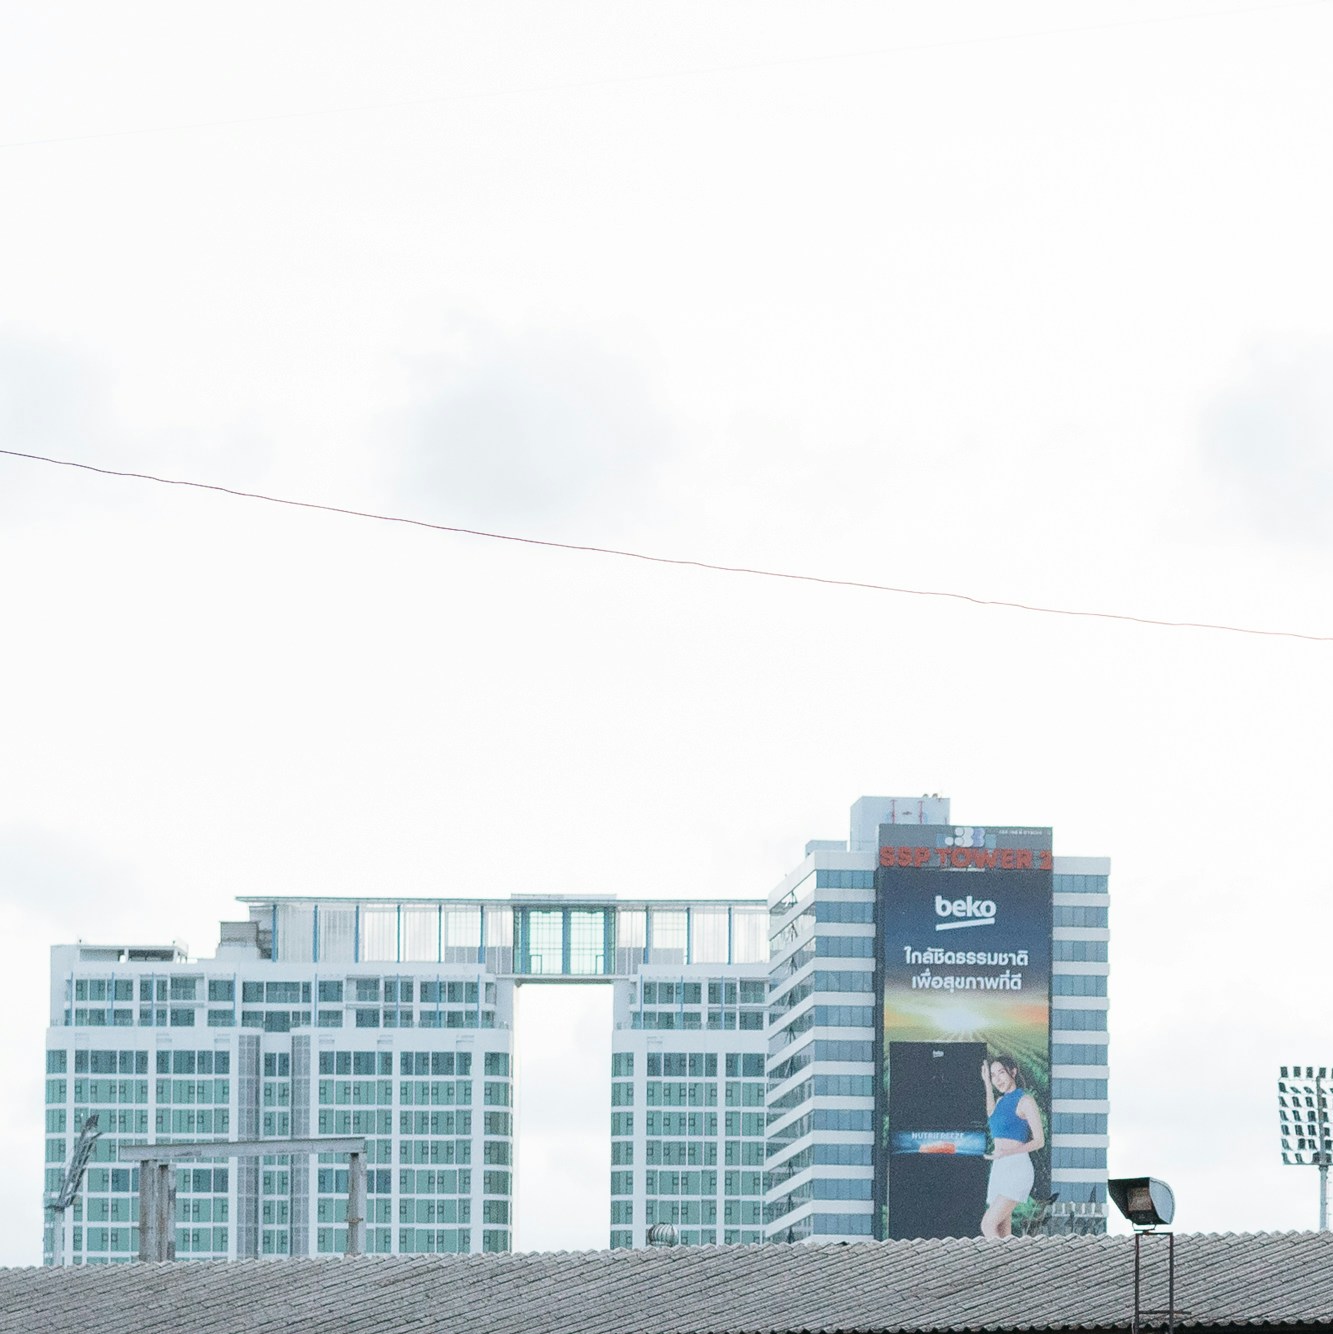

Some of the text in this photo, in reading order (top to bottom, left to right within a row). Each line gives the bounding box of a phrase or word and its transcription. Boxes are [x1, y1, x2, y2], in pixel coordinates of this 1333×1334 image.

[879, 846, 931, 868] SSP
[935, 848, 1033, 870] TOWER
[935, 895, 997, 918] beko
[903, 946, 1029, 966] ใกล้ชิดธรรมชาติ
[911, 968, 1023, 993] เพื่อสุขภาพที่ดี
